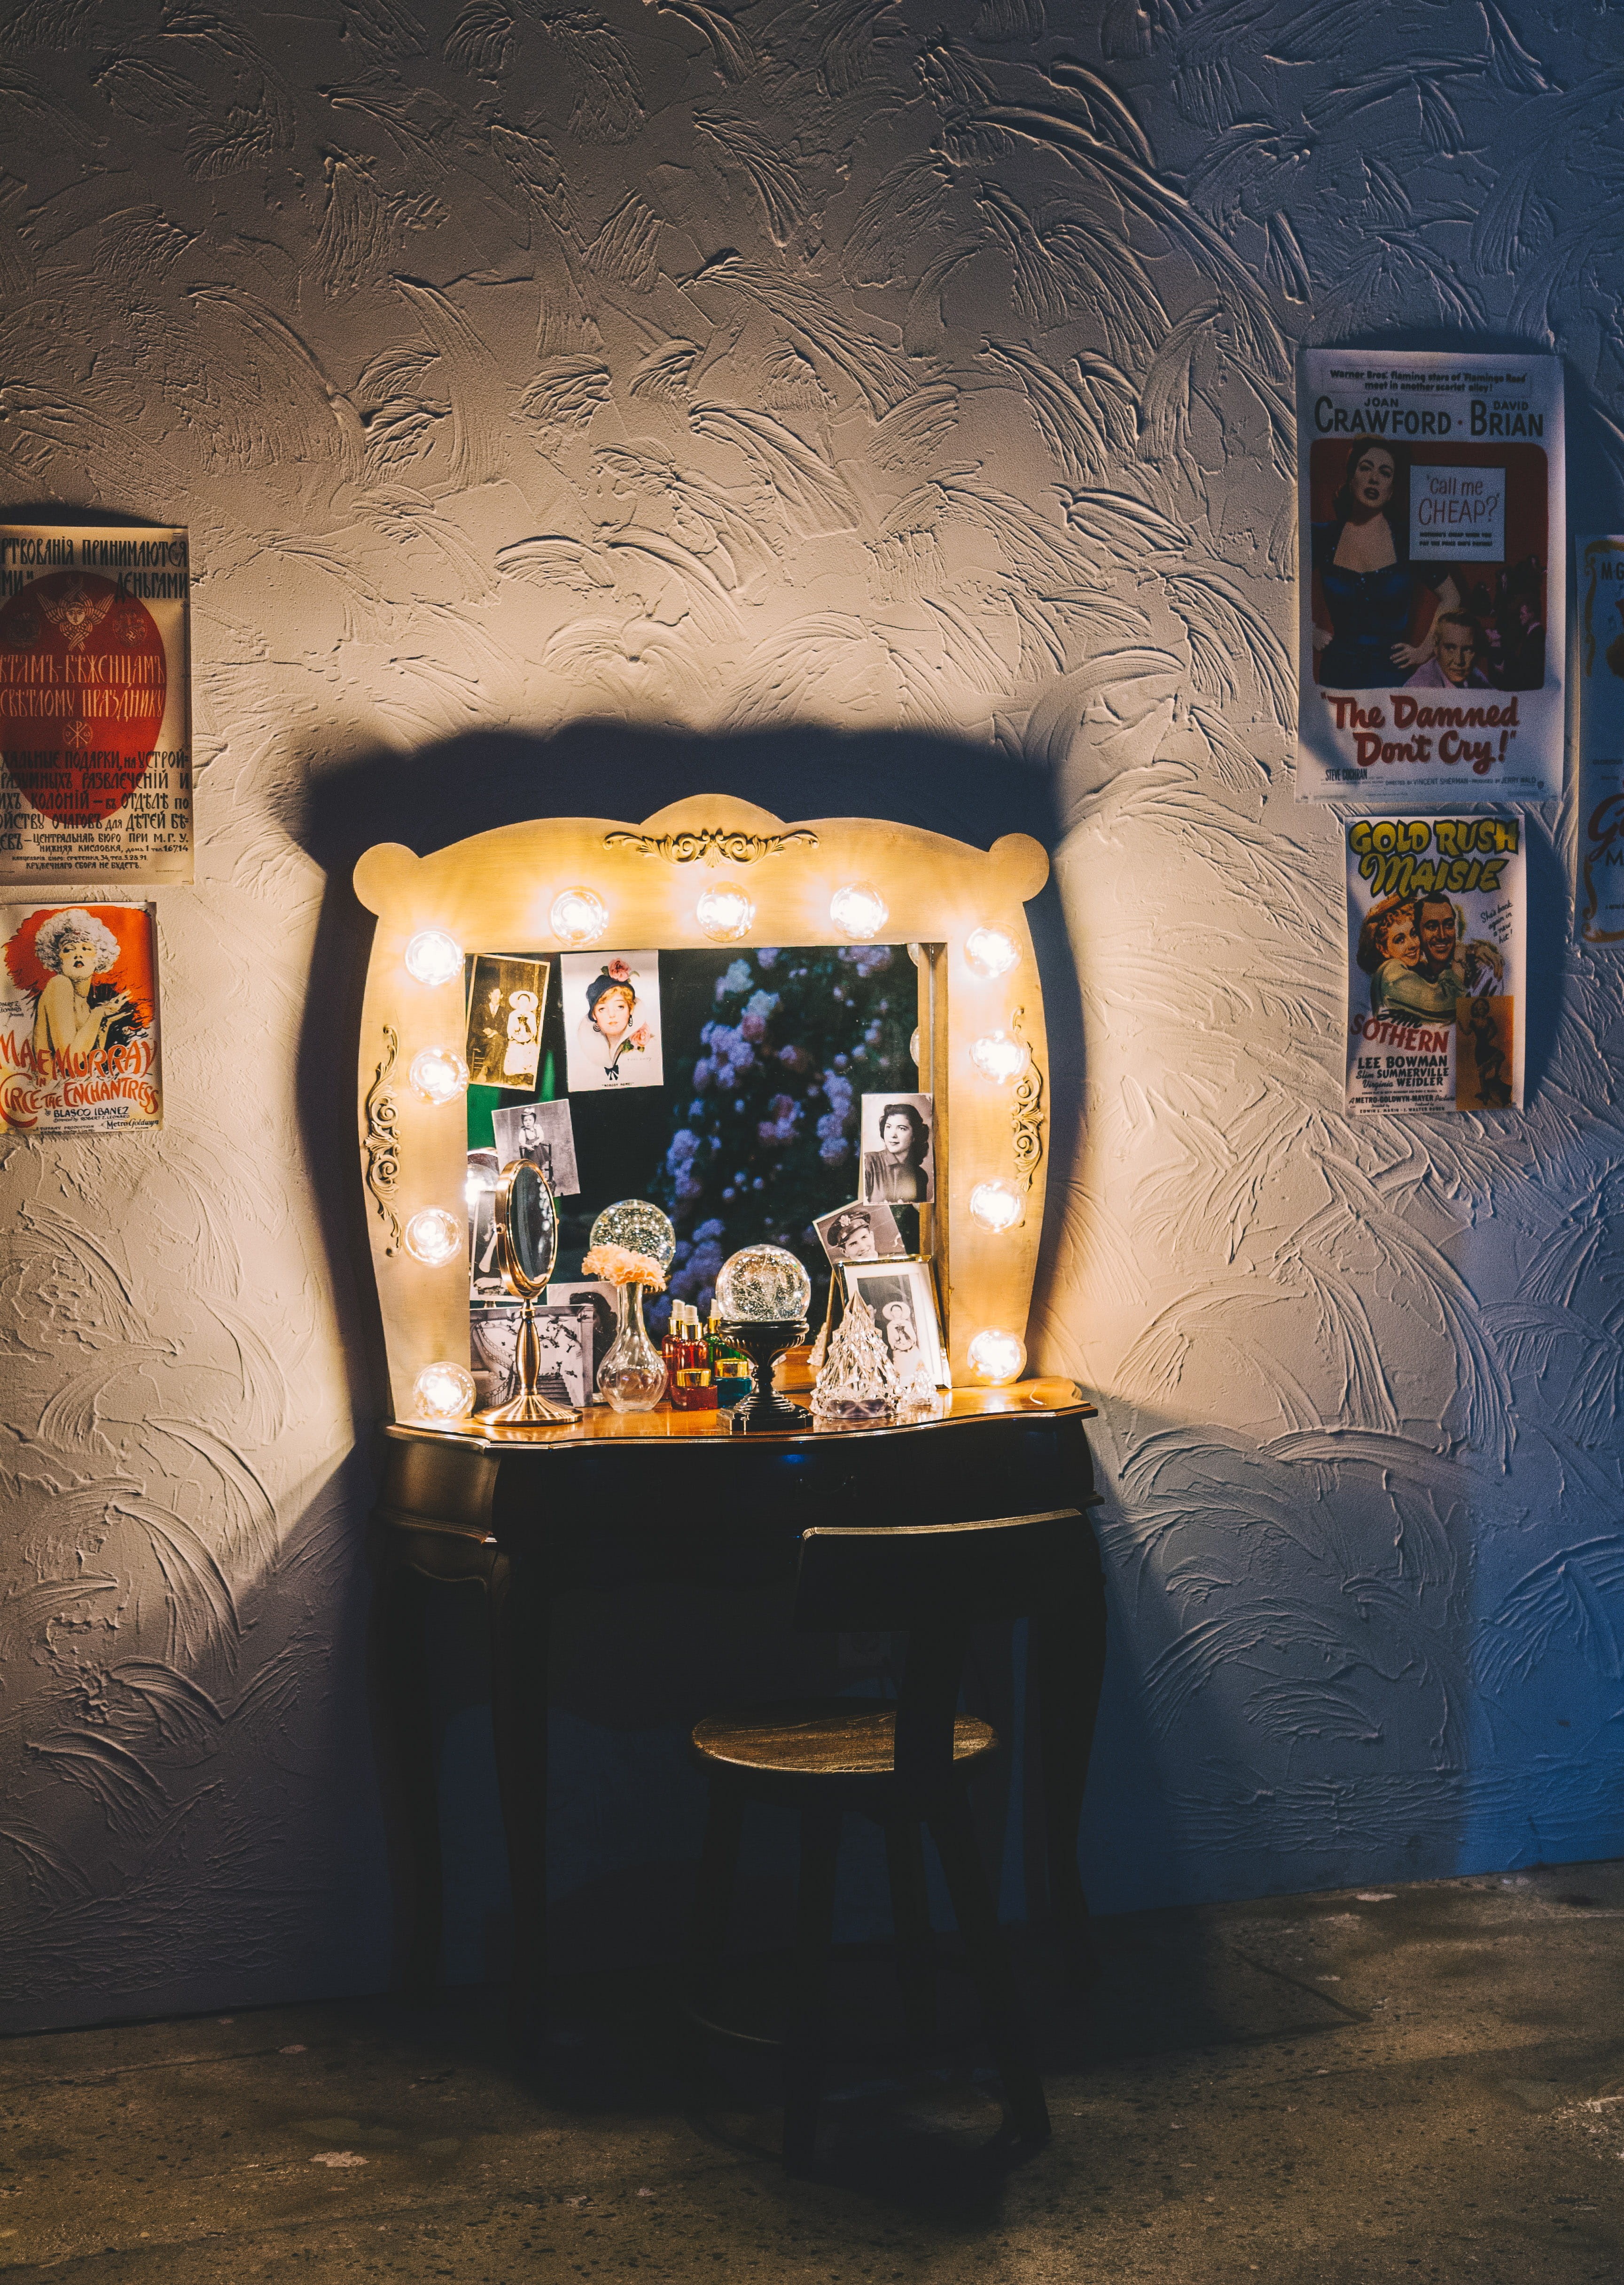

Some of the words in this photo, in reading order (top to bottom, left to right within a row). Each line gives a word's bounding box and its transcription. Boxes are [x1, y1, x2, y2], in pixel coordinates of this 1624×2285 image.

[1330, 370, 1365, 379] Warner
[1391, 371, 1426, 382] flaming
[1365, 381, 1388, 390] meet
[1390, 380, 1398, 390] in
[1400, 382, 1434, 391] another
[1364, 397, 1398, 407] JOAN
[1493, 401, 1529, 411] DAVID
[1316, 395, 1452, 434] CRAWFORD
[1470, 399, 1544, 437] BRIAN
[1460, 480, 1483, 496] me
[82, 539, 188, 567] ПРИНИМАЮТСЯ
[115, 572, 188, 604] ДЕНЬГАМИ
[1390, 694, 1519, 729] Damned
[1353, 731, 1433, 767] Don't
[1326, 768, 1341, 781] STEVE
[0, 833, 23, 852] ЕВЪ
[98, 833, 121, 842] БЮРО
[129, 833, 148, 842] ПРИ
[1348, 819, 1432, 855] GOLD
[1433, 817, 1520, 858] RUSH
[1358, 853, 1510, 898] MAISIE
[1350, 1014, 1449, 1053] SOTHERN
[0, 1029, 51, 1076] MAE
[52, 1040, 157, 1081] MURRAY
[1358, 1057, 1381, 1069] LEE
[1386, 1055, 1448, 1068] BOWMAN
[1356, 1070, 1374, 1079] Slim
[1376, 1067, 1449, 1079] SUMMERVILLE
[36, 1076, 46, 1087] IN
[1362, 1079, 1394, 1090] Virginia
[1396, 1076, 1444, 1087] WEIDLER
[0, 1072, 43, 1128] CIRCE
[41, 1092, 63, 1109] THE
[64, 1077, 159, 1114] ENCHANTRESS
[1355, 1094, 1433, 1104] METRO-GOLDWYN-MAYER
[54, 1108, 91, 1118] BLASCO
[94, 1106, 129, 1116] IBANEZ
[107, 1121, 128, 1130] Metro
[128, 1118, 159, 1129] Goldwyn
